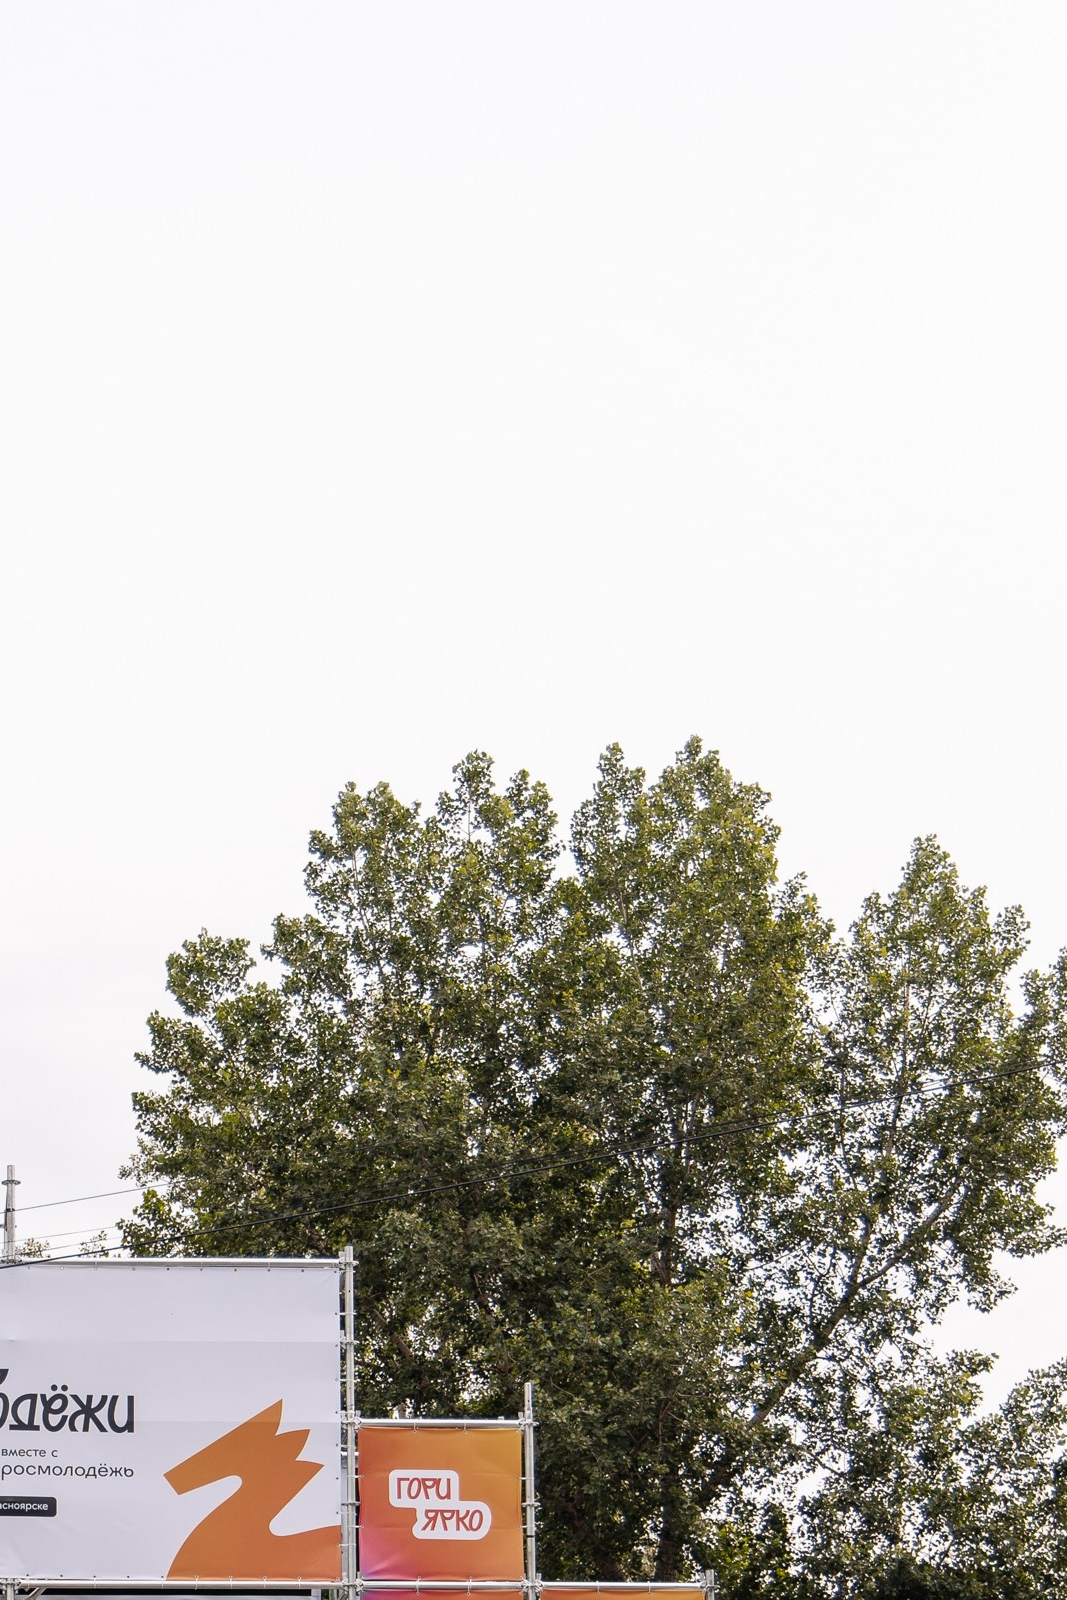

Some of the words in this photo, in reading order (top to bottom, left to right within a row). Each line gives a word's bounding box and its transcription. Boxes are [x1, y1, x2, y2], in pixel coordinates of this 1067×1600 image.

[1, 1448, 46, 1458] вместе
[51, 1449, 58, 1458] с
[1, 1463, 134, 1480] росмолодёжь
[396, 1477, 452, 1500] ГОРИ
[421, 1509, 484, 1532] ЯРКО
